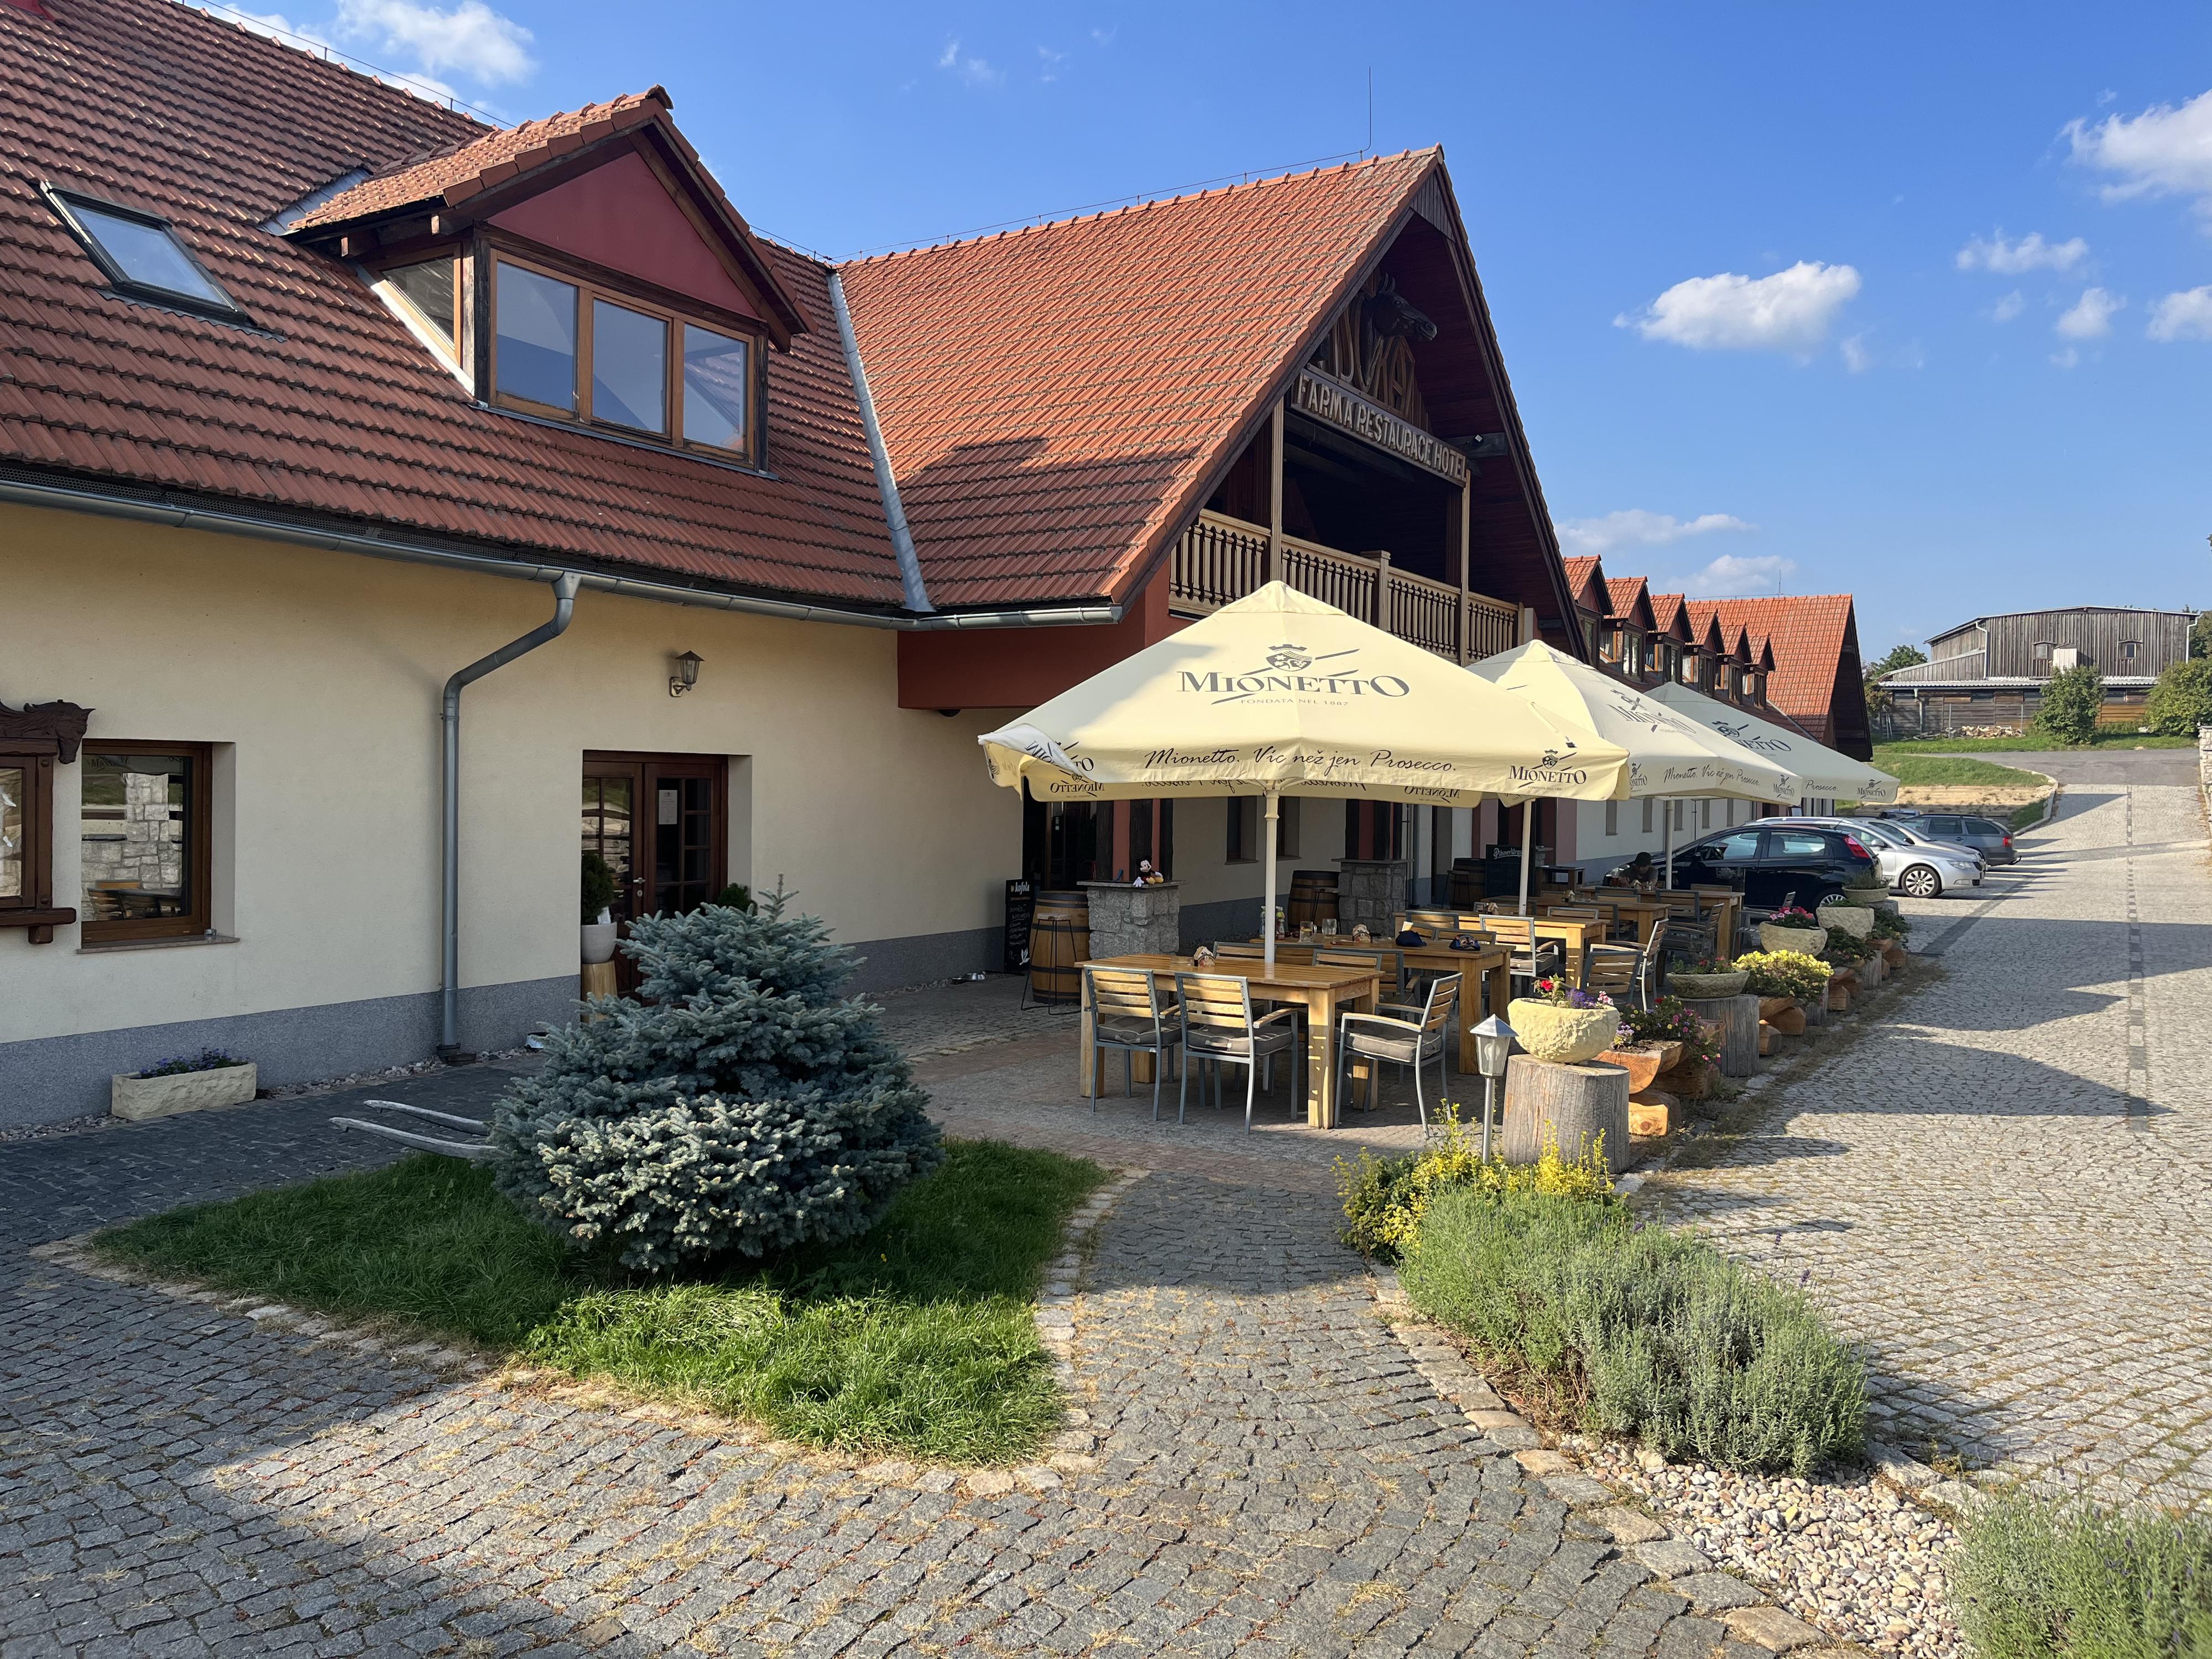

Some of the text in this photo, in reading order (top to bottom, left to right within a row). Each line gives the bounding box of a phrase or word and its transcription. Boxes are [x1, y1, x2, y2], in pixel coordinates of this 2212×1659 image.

[1297, 373, 1467, 482] FARMA RESTAURACE HOTEL
[1177, 671, 1410, 697] MIONETTO
[1144, 748, 1239, 769] Mionetto.
[1292, 750, 1326, 764] než
[1324, 751, 1360, 776] jen
[1370, 749, 1456, 771] Prosecco.
[1508, 765, 1587, 784] MIONETTO
[1493, 848, 1511, 859] Pilsner
[1014, 881, 1030, 895] kofola
